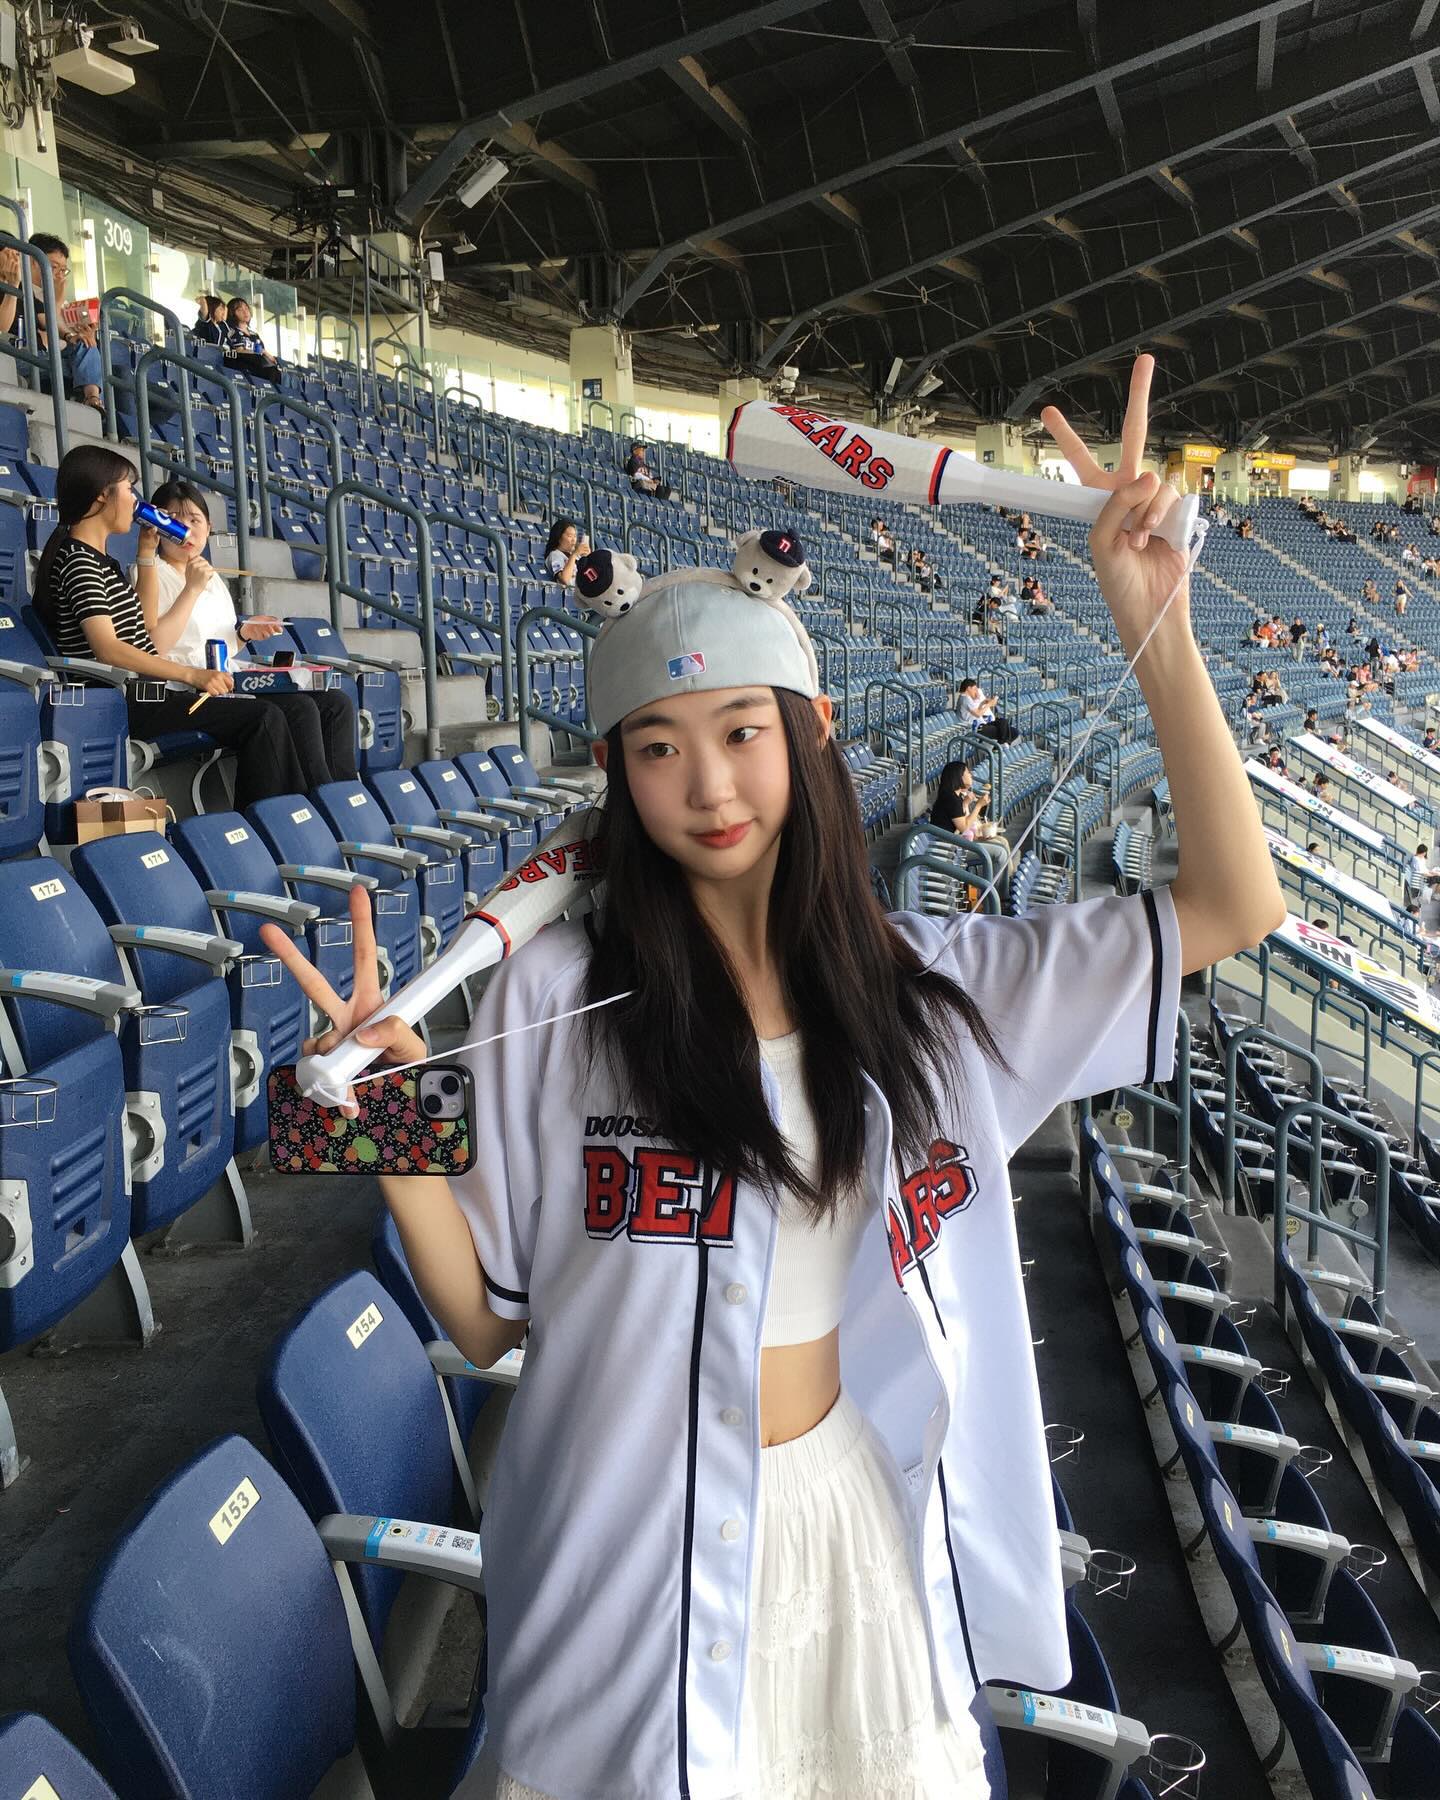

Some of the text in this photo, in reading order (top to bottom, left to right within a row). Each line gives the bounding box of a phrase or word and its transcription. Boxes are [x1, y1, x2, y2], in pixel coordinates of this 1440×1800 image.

[103, 217, 133, 256] 309
[768, 405, 896, 490] BEARS
[229, 830, 245, 842] 170
[146, 852, 165, 866] 171
[37, 882, 61, 897] 172
[355, 1311, 376, 1339] 154
[221, 1490, 250, 1529] 153
